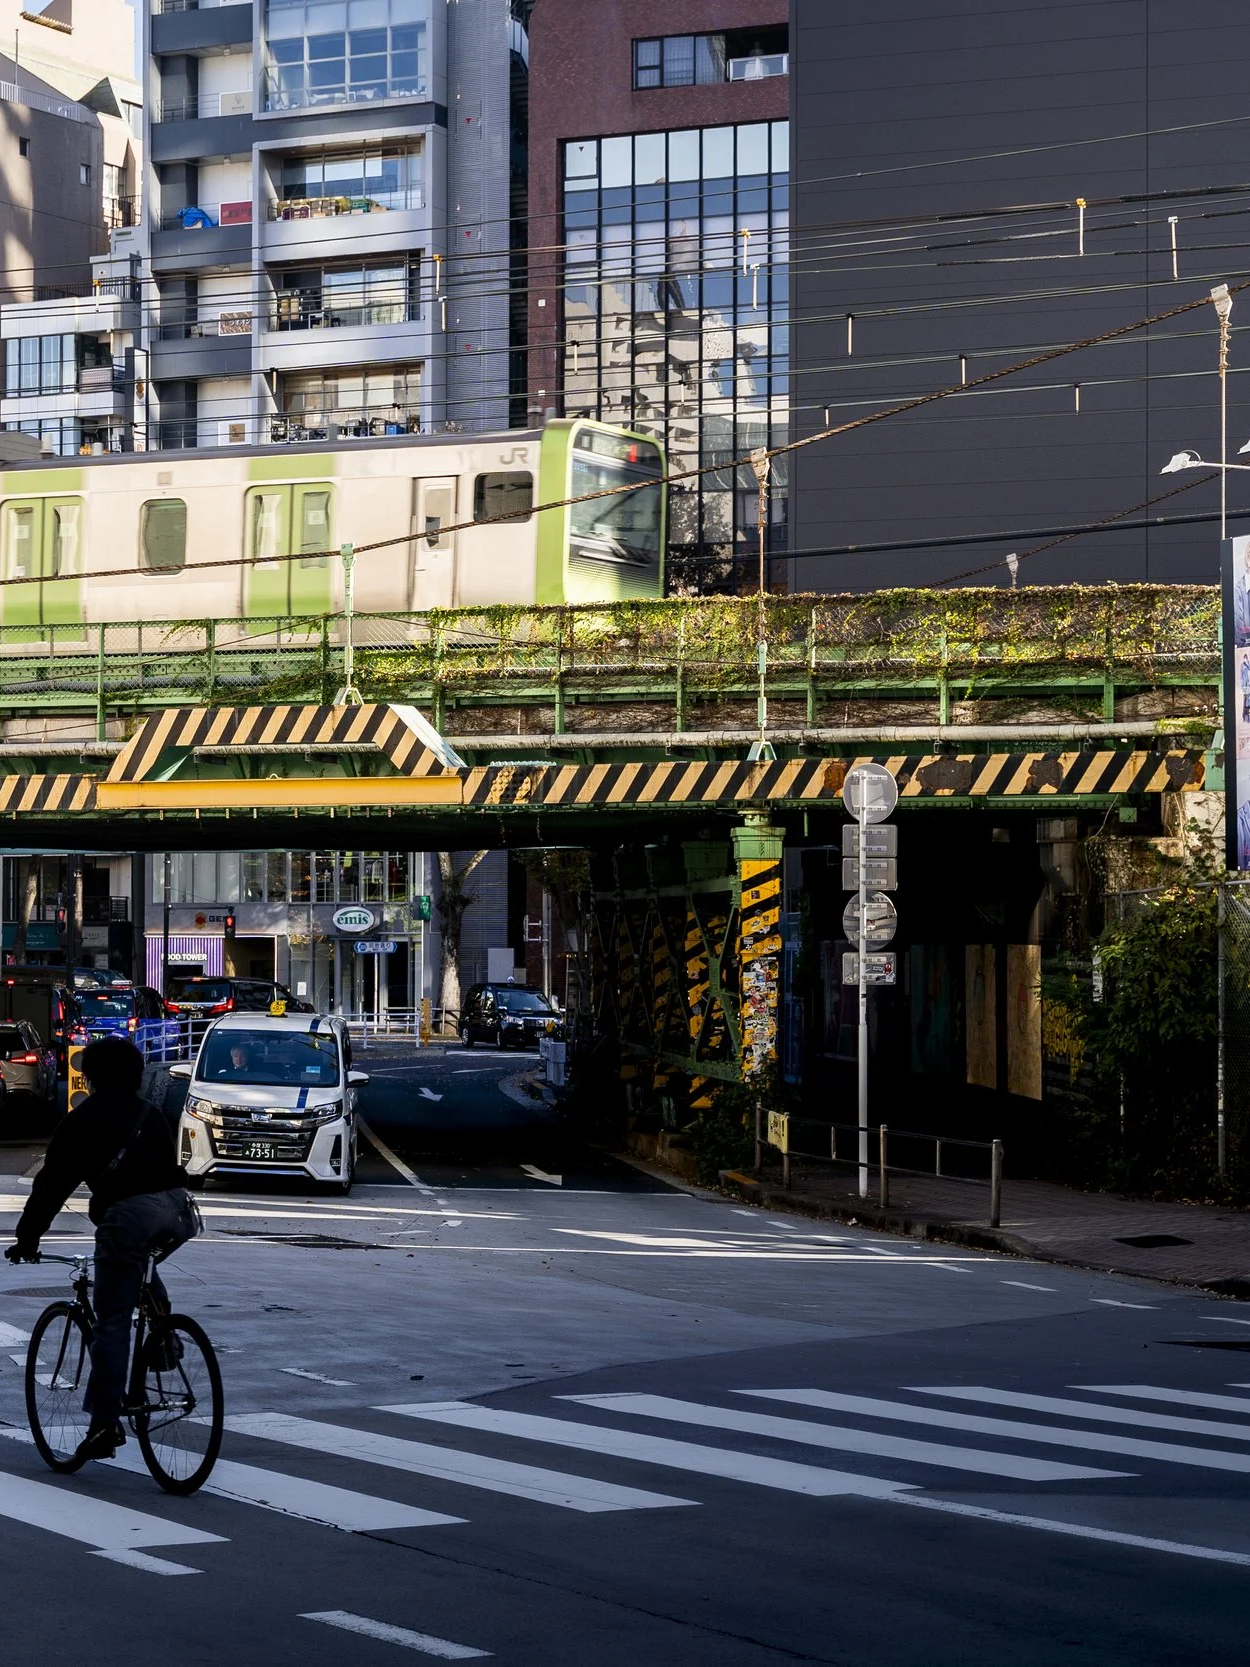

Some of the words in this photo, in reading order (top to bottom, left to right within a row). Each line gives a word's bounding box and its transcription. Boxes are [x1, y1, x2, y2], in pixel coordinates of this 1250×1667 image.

[499, 447, 528, 465] JR
[208, 915, 226, 923] GE
[336, 914, 369, 925] emis
[182, 953, 208, 961] TOWER
[250, 1148, 274, 1158] 73-51
